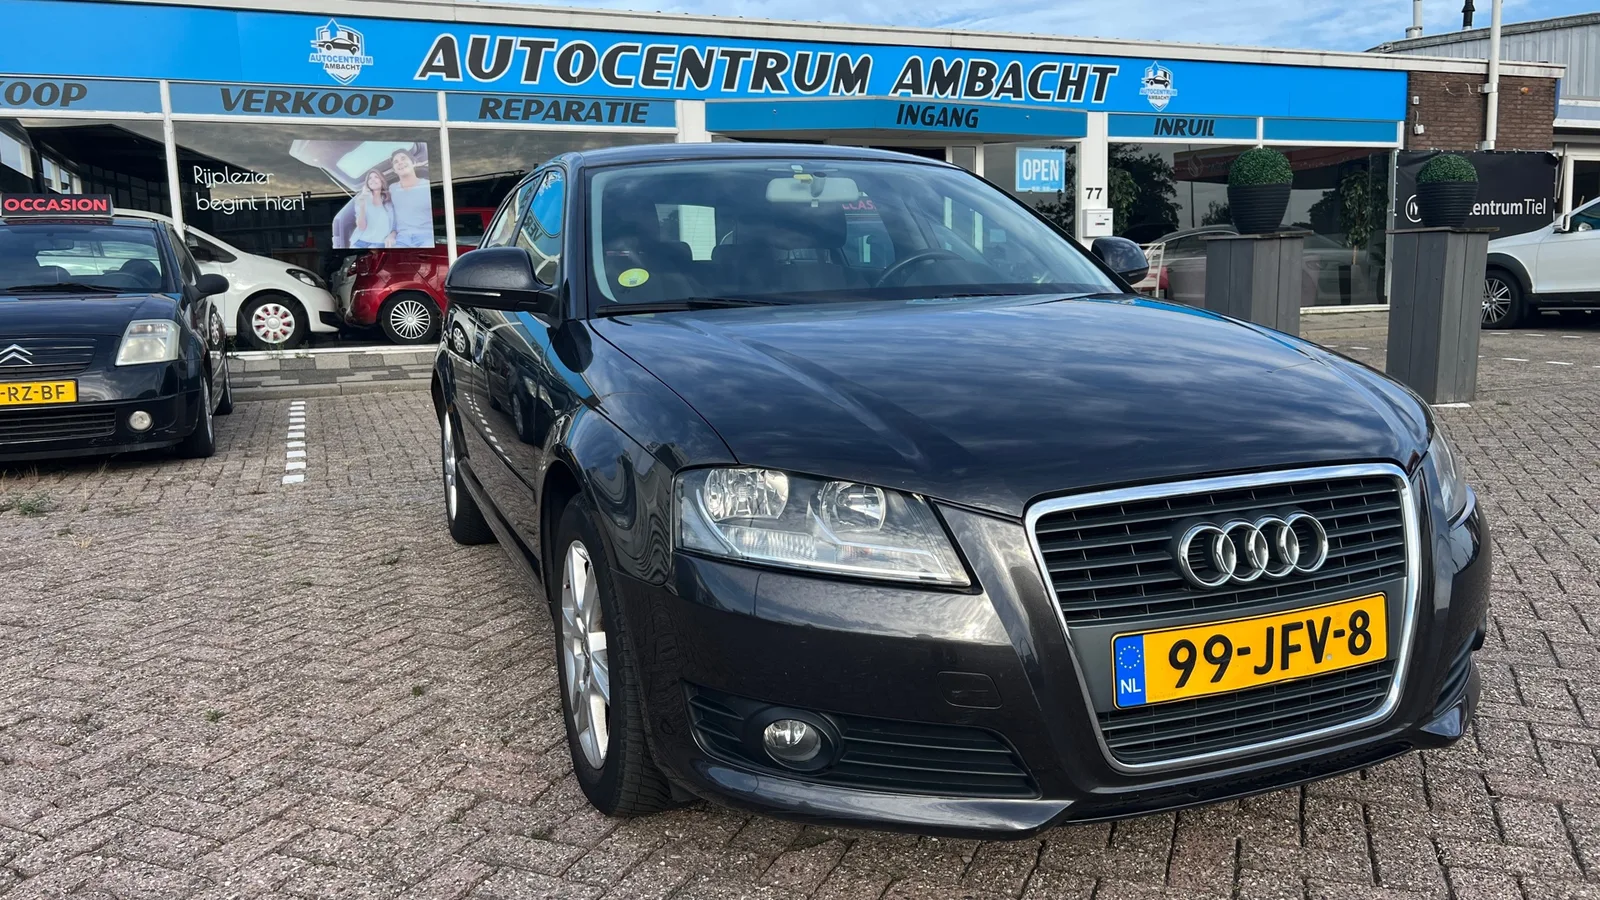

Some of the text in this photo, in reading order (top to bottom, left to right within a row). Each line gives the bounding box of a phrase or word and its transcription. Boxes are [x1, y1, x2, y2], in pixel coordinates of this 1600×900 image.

[310, 54, 372, 64] AUTOCENTRUM
[414, 33, 1119, 103] AUTOCENTRUM AMBACHT
[220, 88, 394, 116] VERKOOP
[478, 98, 650, 124] REPARATIE
[896, 104, 979, 129] INGANG
[1153, 117, 1215, 137] INRUIL
[193, 165, 274, 188] Rijplezier
[1022, 158, 1060, 181] OPEN
[4, 198, 107, 211] OCCASION
[196, 192, 305, 214] begint hier!
[1085, 187, 1103, 200] 77
[1469, 198, 1547, 216] entrum Tiel
[1168, 610, 1372, 689] 99-JFV-8
[1120, 678, 1142, 695] NL
